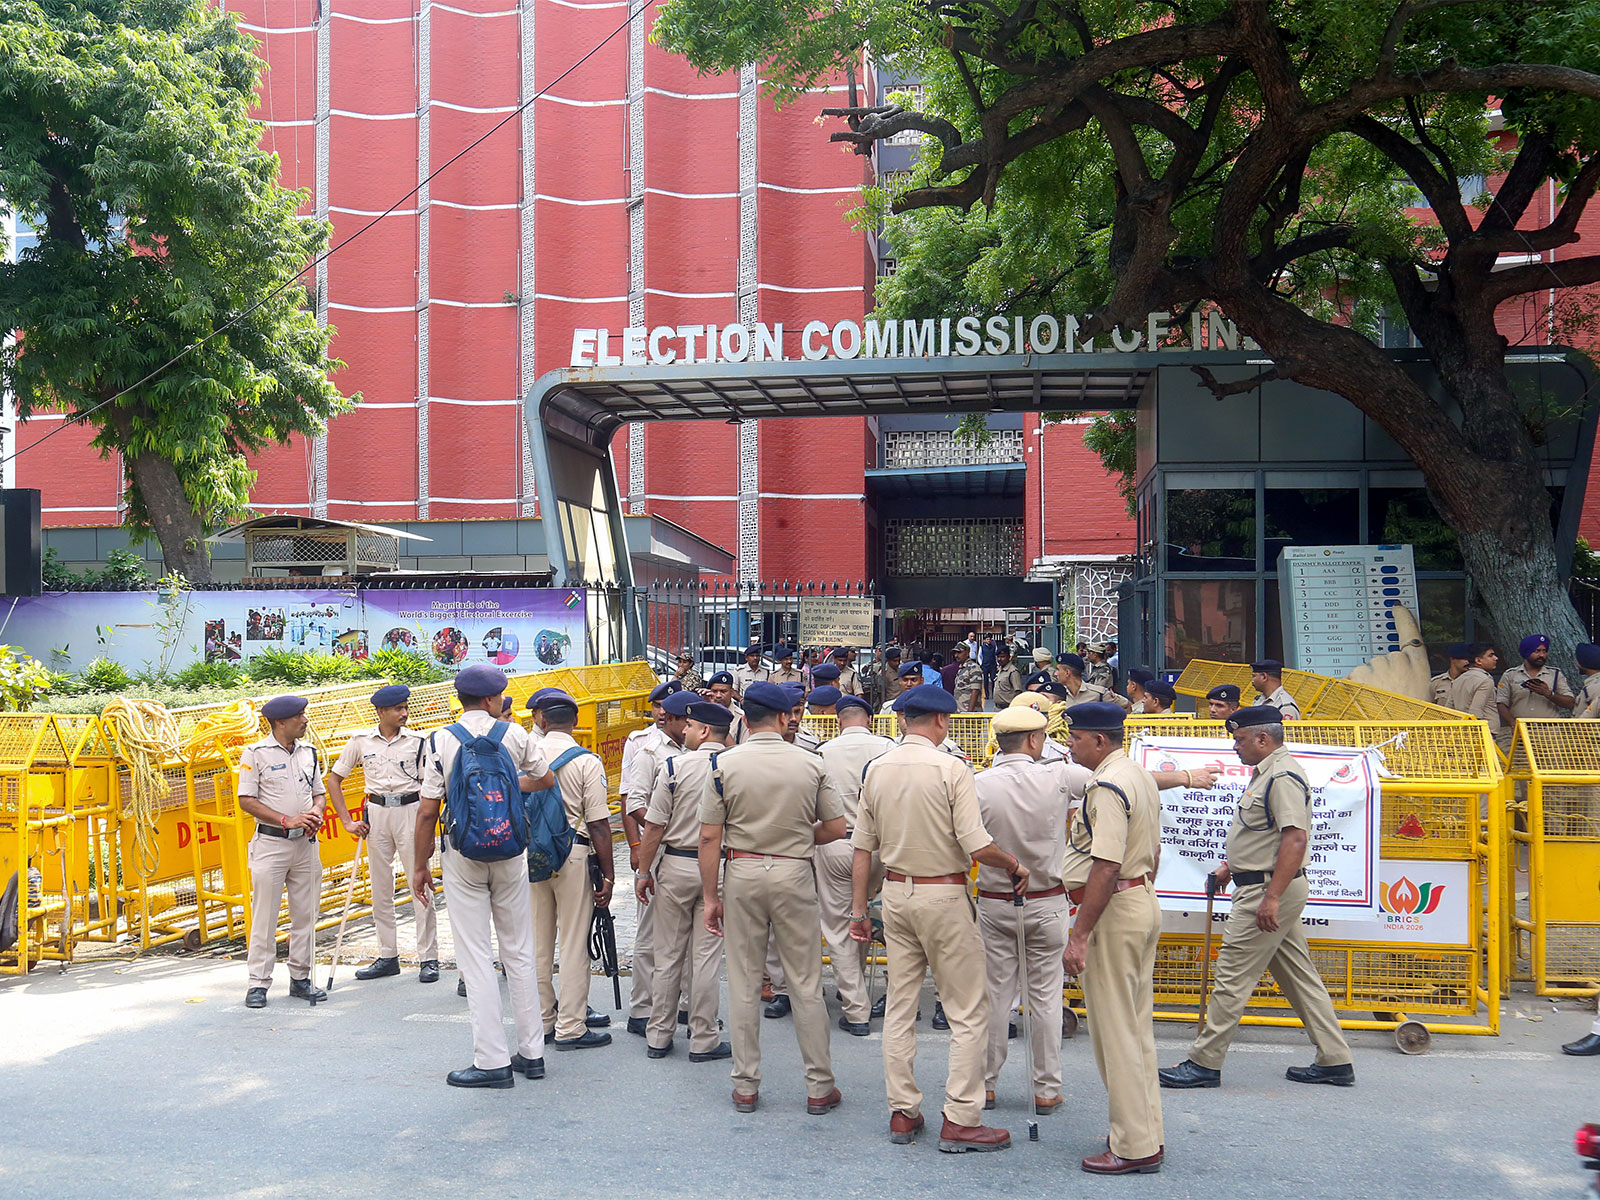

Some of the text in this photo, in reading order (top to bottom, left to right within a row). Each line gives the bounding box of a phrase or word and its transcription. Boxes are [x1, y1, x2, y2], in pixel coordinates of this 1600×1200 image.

[570, 322, 784, 367] ELECTION
[801, 314, 1094, 360] COMMISSION
[431, 600, 500, 610] Magnitude of the
[399, 610, 533, 620] World's Biggest Electoral Excercise
[1303, 612, 1309, 620] 5
[1305, 657, 1312, 665] 9
[1219, 793, 1235, 803] की
[1166, 804, 1179, 812] या
[1211, 805, 1234, 816] अधि
[1337, 809, 1352, 818] का
[1387, 915, 1420, 923] BRICS
